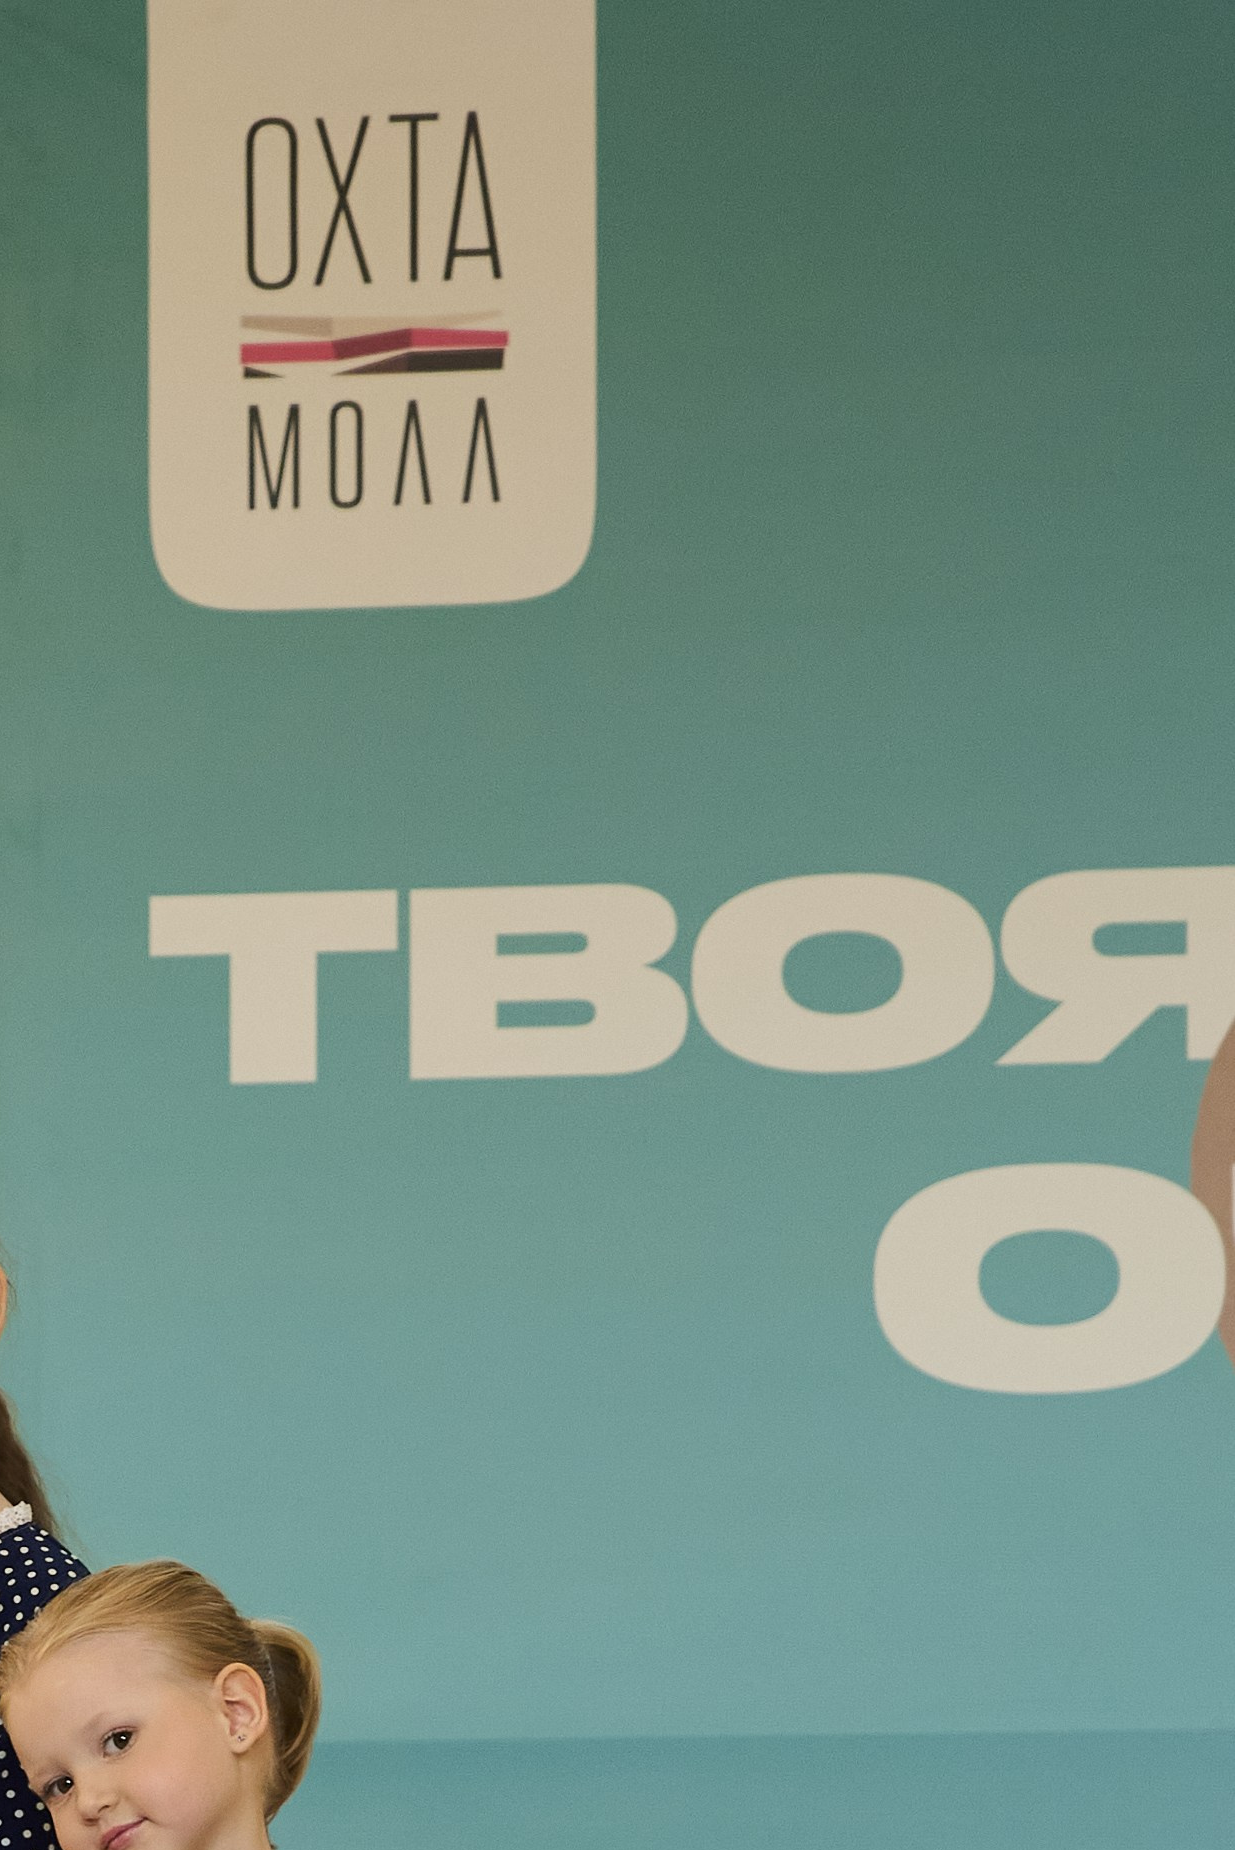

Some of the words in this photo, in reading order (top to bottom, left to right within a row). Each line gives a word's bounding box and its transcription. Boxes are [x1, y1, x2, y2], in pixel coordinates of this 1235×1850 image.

[245, 110, 502, 290] ОХТА
[247, 397, 500, 510] МОЛЛ
[148, 866, 1235, 1085] ТВОЯ
